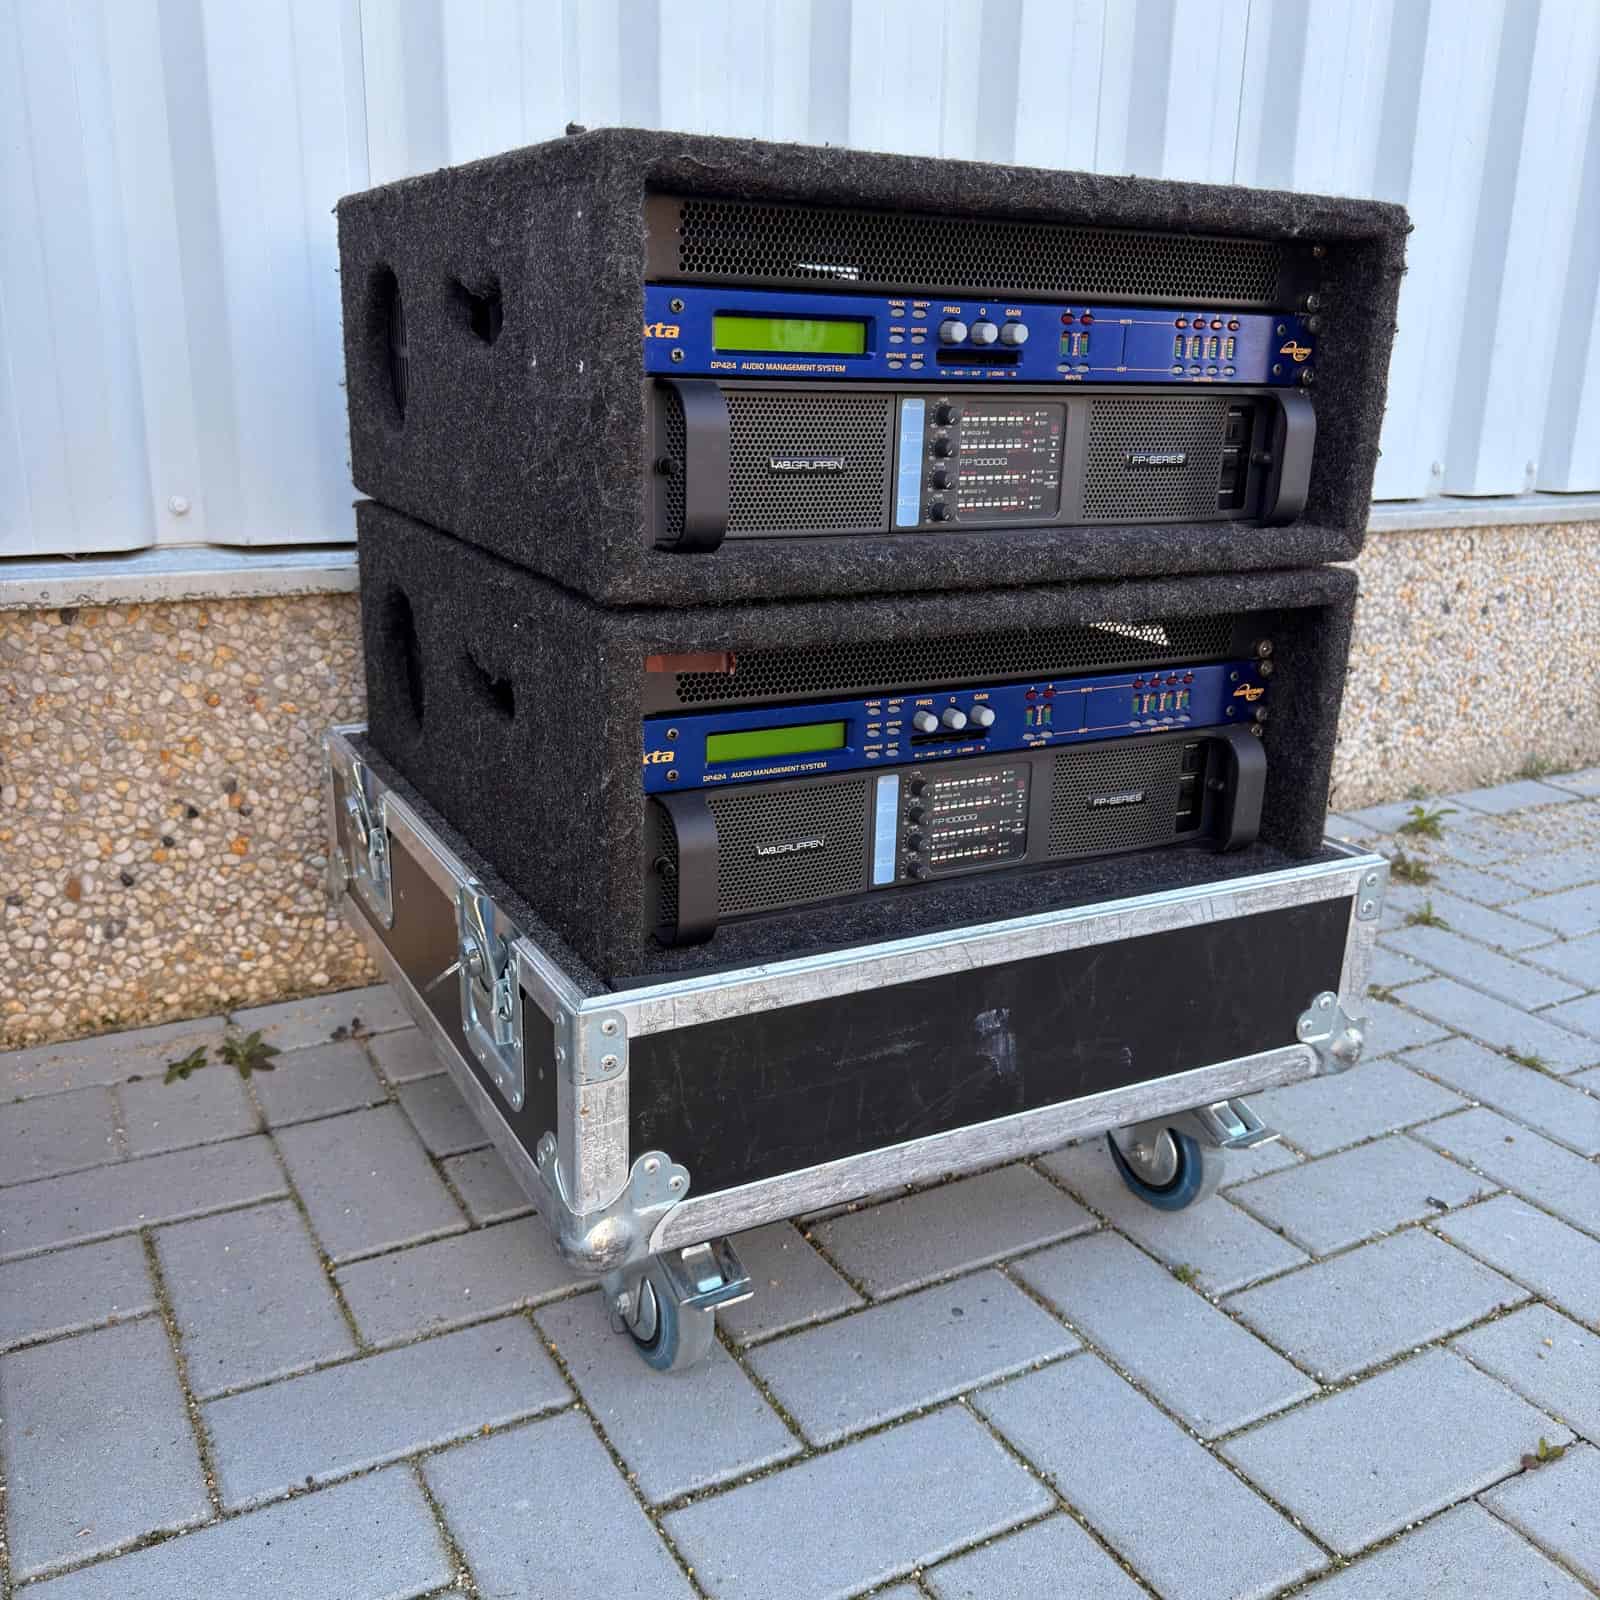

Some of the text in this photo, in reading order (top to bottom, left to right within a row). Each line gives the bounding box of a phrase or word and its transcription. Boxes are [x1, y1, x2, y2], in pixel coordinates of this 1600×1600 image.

[741, 362, 765, 371] AUDIO
[766, 362, 816, 372] MANAGEMENT
[816, 364, 847, 373] SYSTEM
[730, 771, 753, 779] AUDIO
[752, 764, 800, 777] MANAGEMENT
[799, 761, 828, 771] SYSTEM
